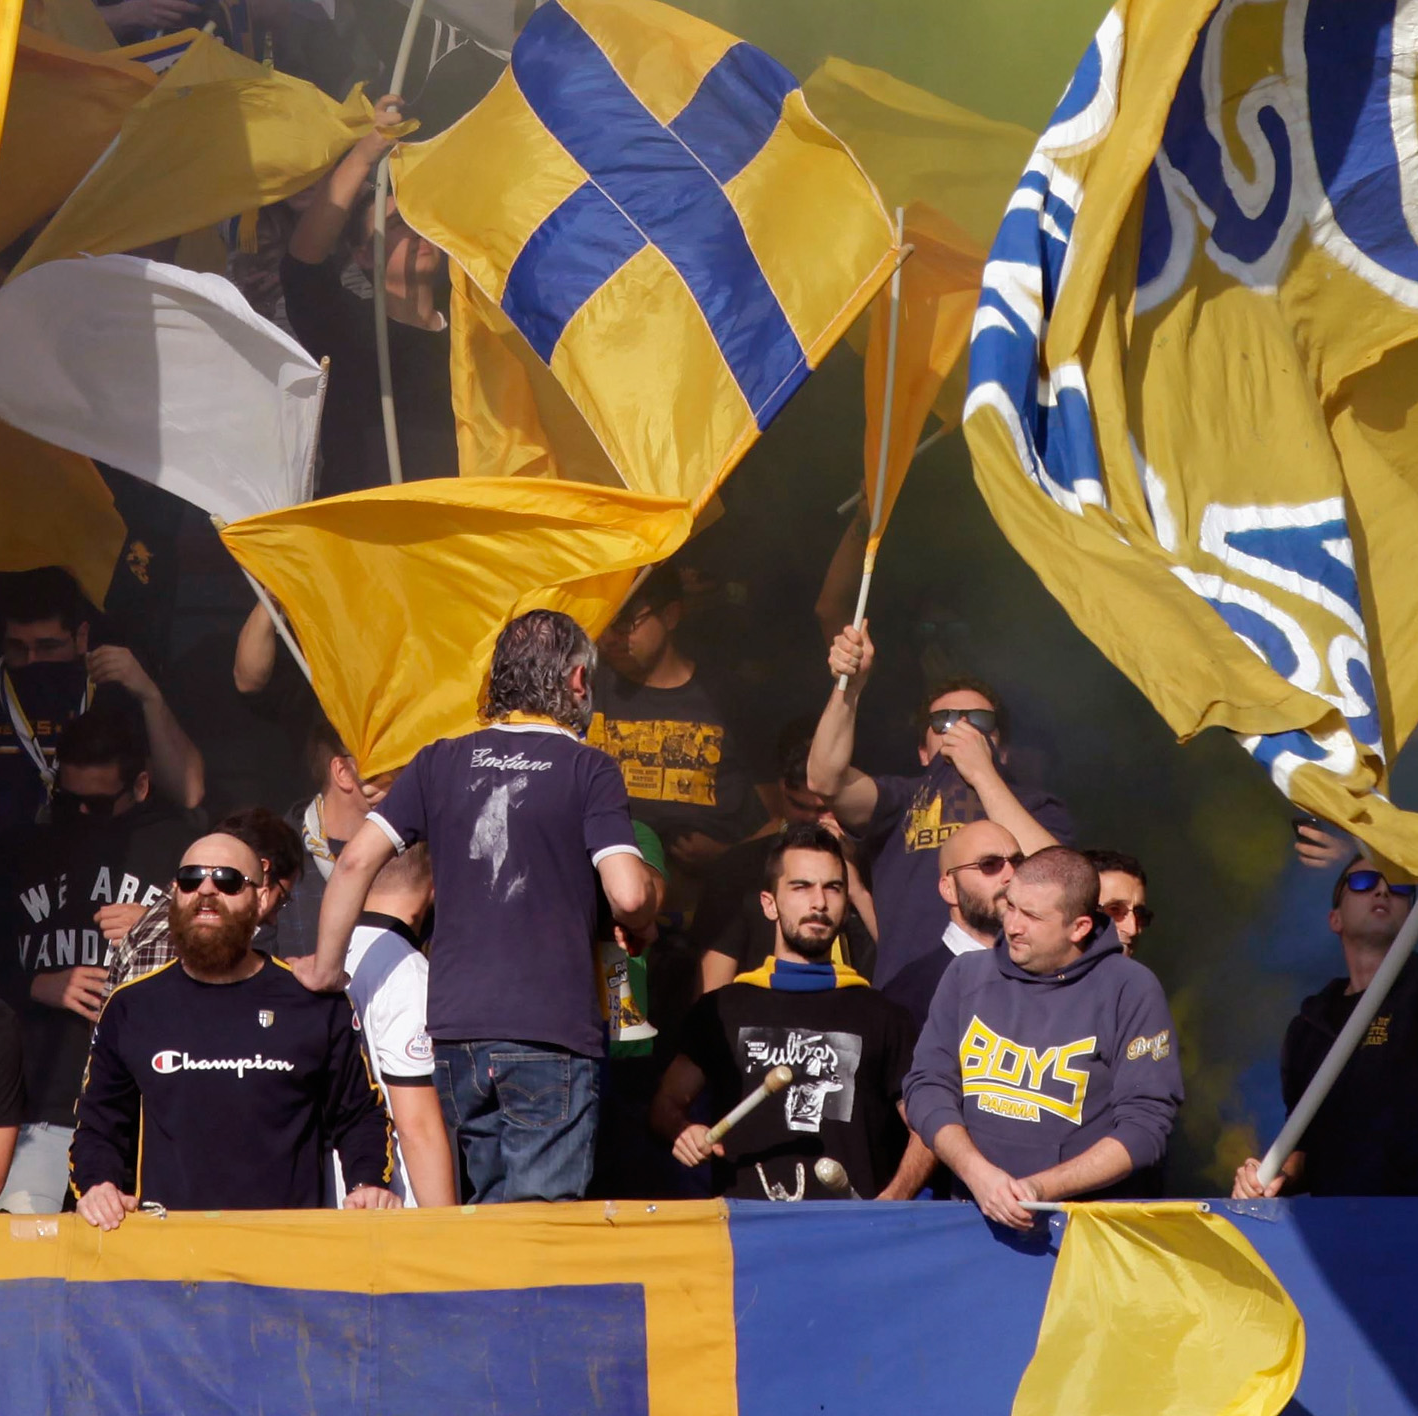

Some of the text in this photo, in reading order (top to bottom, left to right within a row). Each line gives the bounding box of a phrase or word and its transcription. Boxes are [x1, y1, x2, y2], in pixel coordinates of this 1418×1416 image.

[471, 748, 553, 771] Emiliano
[763, 1032, 838, 1066] ultras
[151, 1050, 295, 1078] Champion
[960, 1015, 1097, 1125] BOYS
[978, 1093, 1041, 1122] PARMA
